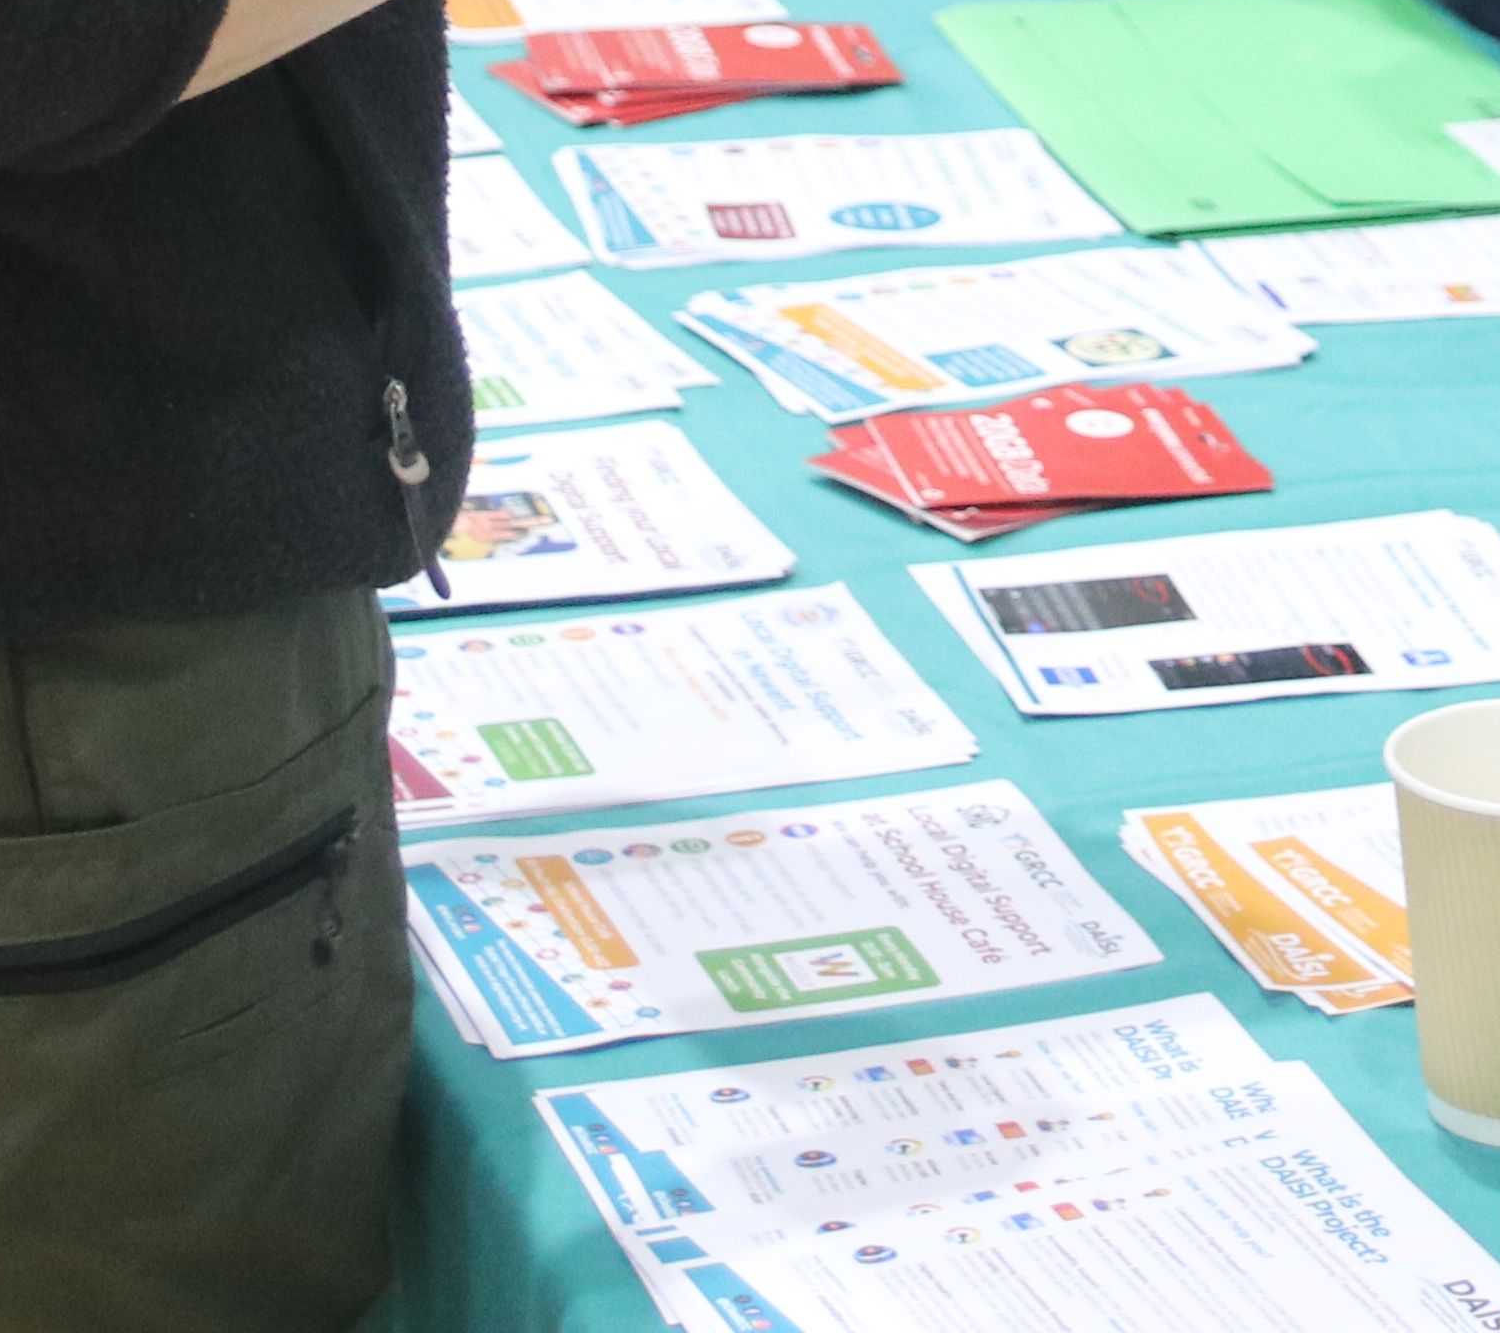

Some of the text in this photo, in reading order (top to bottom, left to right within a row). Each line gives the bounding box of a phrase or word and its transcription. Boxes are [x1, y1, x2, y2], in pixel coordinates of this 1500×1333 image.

[804, 689, 863, 741] Support
[860, 813, 1004, 965] at School House Café
[907, 808, 1053, 957] Local Digital Support
[1013, 850, 1064, 890] GRCC
[1173, 846, 1226, 890] GRCC
[1290, 866, 1354, 907] GRCC
[1270, 932, 1337, 978] DAISI
[1112, 1024, 1158, 1064] DAISI
[1143, 1018, 1189, 1059] What
[1176, 1060, 1200, 1073] is
[1183, 1175, 1274, 1259] How can we help you?
[1260, 1156, 1389, 1264] DAISI Project?
[1291, 1149, 1392, 1238] What is the
